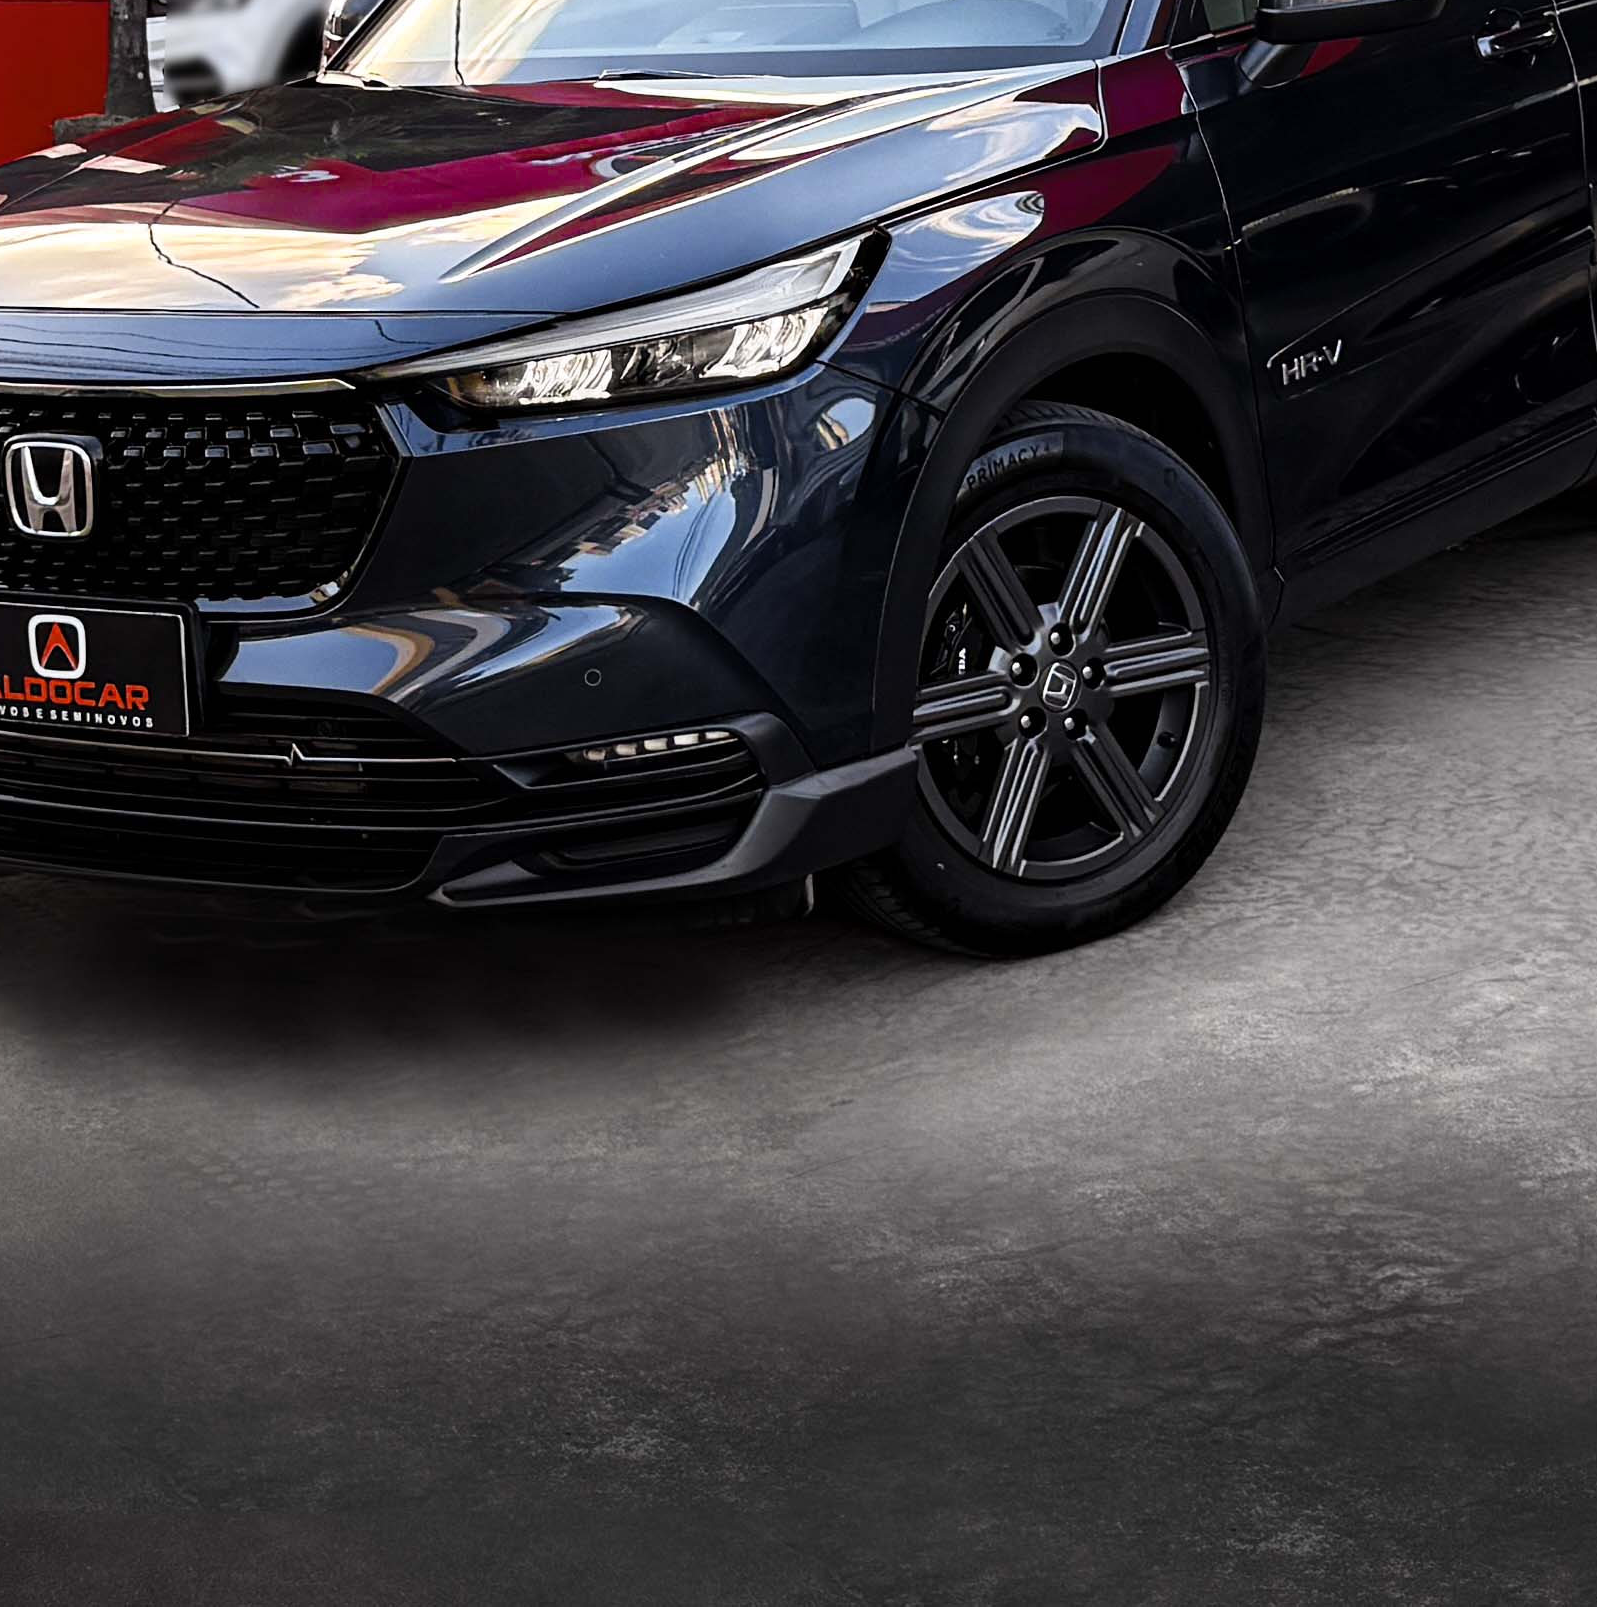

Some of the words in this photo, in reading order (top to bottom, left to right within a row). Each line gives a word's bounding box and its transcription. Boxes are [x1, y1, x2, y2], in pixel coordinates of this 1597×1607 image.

[1281, 339, 1342, 386] HR-V
[966, 443, 1038, 490] PRIMACY
[36, 708, 44, 720] E
[50, 709, 154, 729] SEMINOVOS
